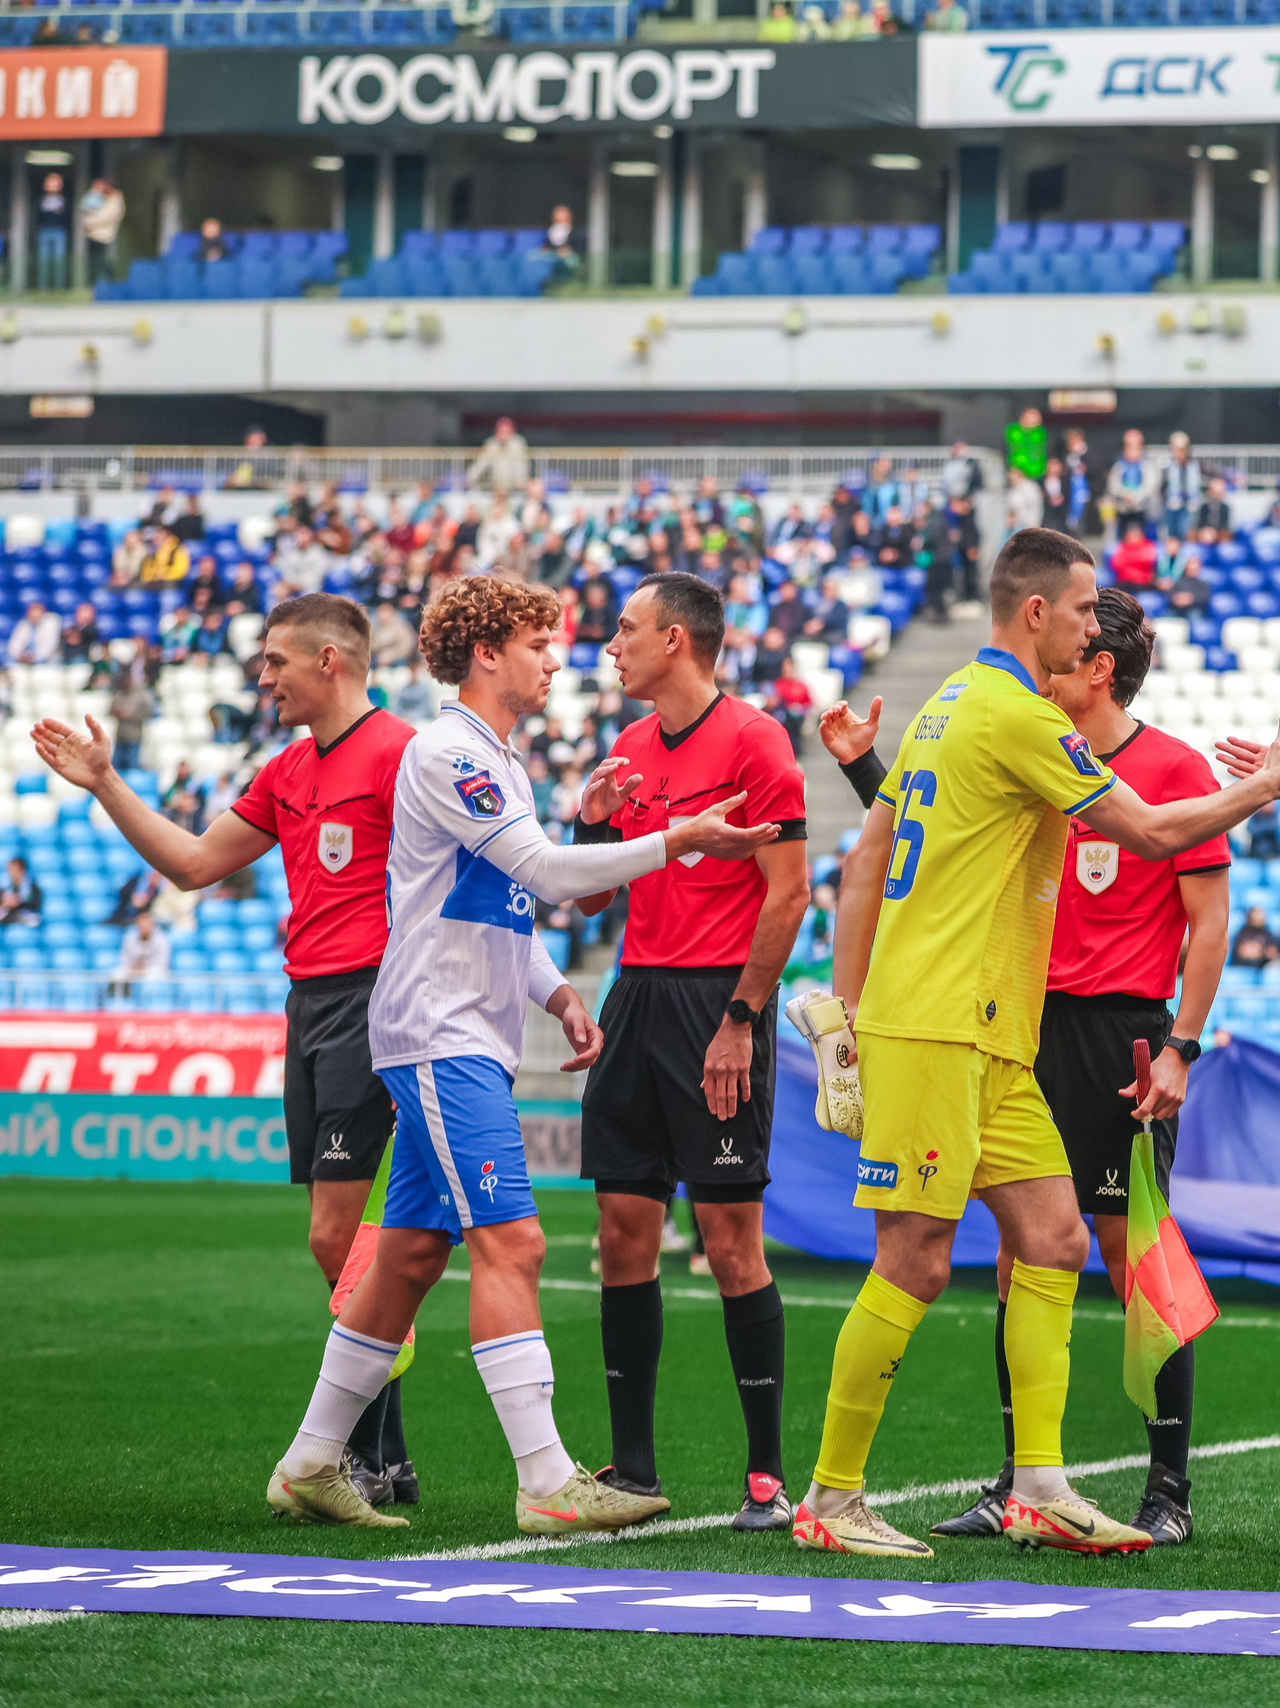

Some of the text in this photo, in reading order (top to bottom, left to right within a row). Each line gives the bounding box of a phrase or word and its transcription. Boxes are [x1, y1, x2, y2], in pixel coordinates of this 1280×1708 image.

[0, 58, 139, 119] КИЙ
[1099, 56, 1232, 97] ДСК
[321, 1150, 351, 1160] JOGEL
[713, 1155, 744, 1165] JOGEL
[1095, 1185, 1128, 1197] JOGEL
[0, 1564, 1091, 1619] ЙСКАЯ
